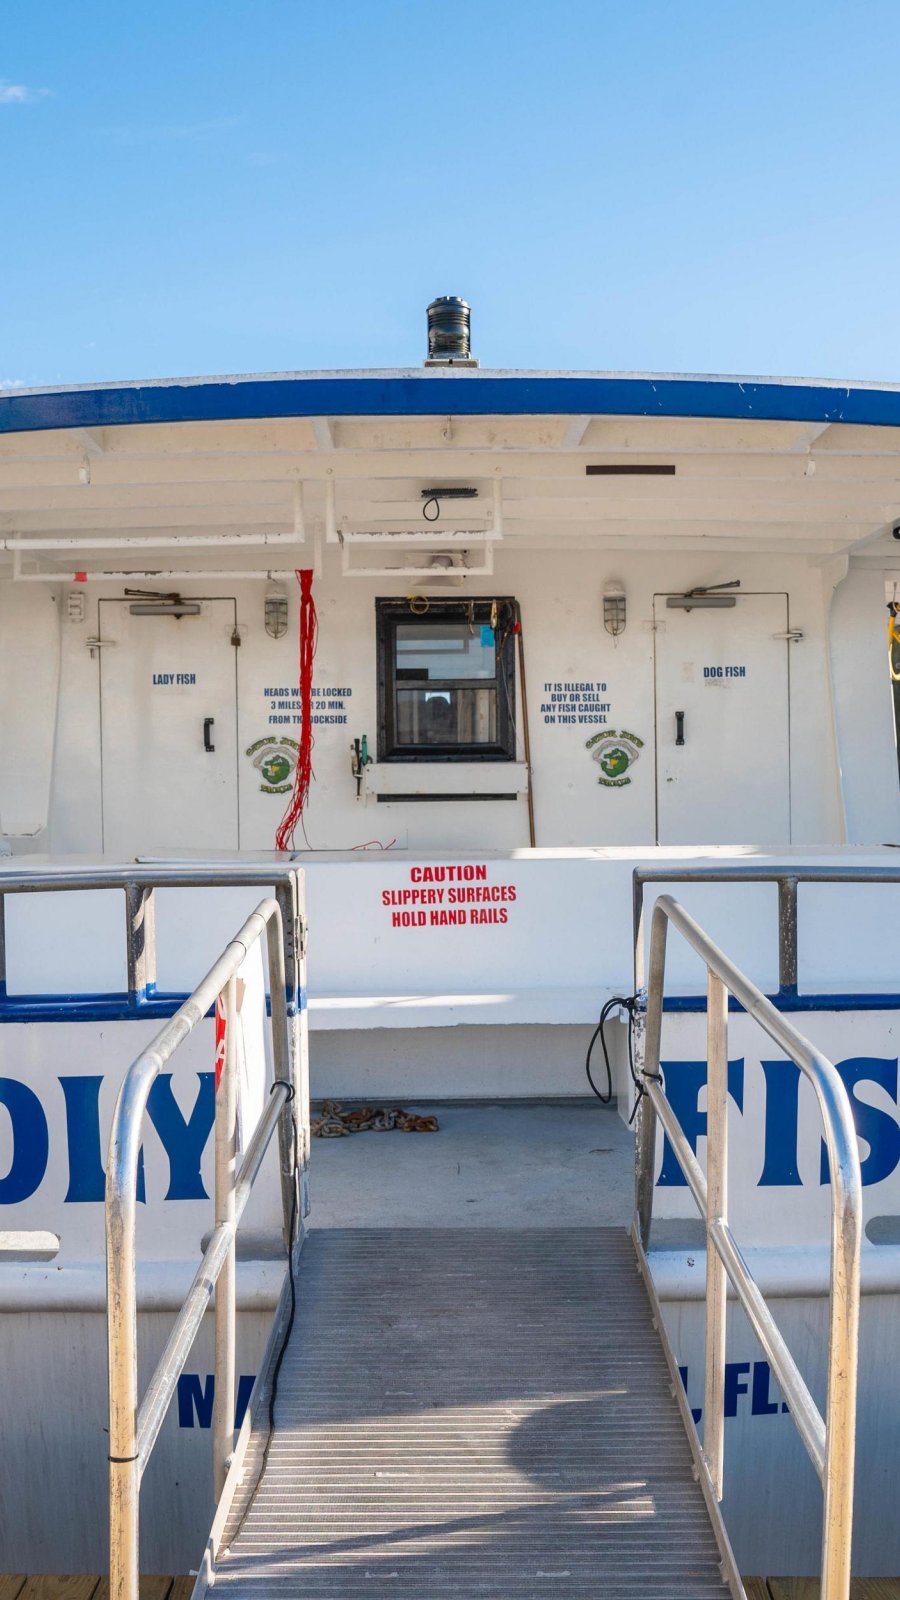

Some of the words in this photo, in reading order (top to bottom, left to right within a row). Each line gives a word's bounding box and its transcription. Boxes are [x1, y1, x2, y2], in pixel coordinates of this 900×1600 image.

[704, 667, 723, 677] DOG
[725, 666, 746, 677] FISH
[153, 674, 174, 685] LADY
[176, 673, 196, 685] FISH
[544, 683, 552, 692] IT
[554, 683, 562, 692] IS
[564, 683, 595, 692] ILLEGAL
[596, 683, 607, 692] TO
[264, 688, 289, 697] HEADS
[311, 688, 321, 697] BE
[323, 688, 352, 697] LOCKED
[551, 694, 567, 702] BUY
[569, 694, 581, 702] OR
[582, 693, 600, 702] SELL
[271, 701, 276, 710] 3
[278, 701, 302, 710] MILES
[316, 701, 326, 710] 20
[328, 701, 346, 710] MIN.
[540, 704, 556, 712] ANY
[558, 704, 576, 712] FISH
[578, 704, 611, 712] CAUGHT
[269, 715, 290, 724] FROM
[293, 715, 303, 724] TH
[544, 715, 555, 724] ON
[557, 715, 577, 724] THIS
[578, 715, 607, 724] VESSEL
[410, 865, 487, 882] CAUTION
[382, 888, 444, 906] SLIPPERY
[448, 886, 517, 903] SURFACES
[392, 911, 426, 927] HOLD
[430, 909, 466, 926] HAND
[470, 908, 508, 924] RAILS
